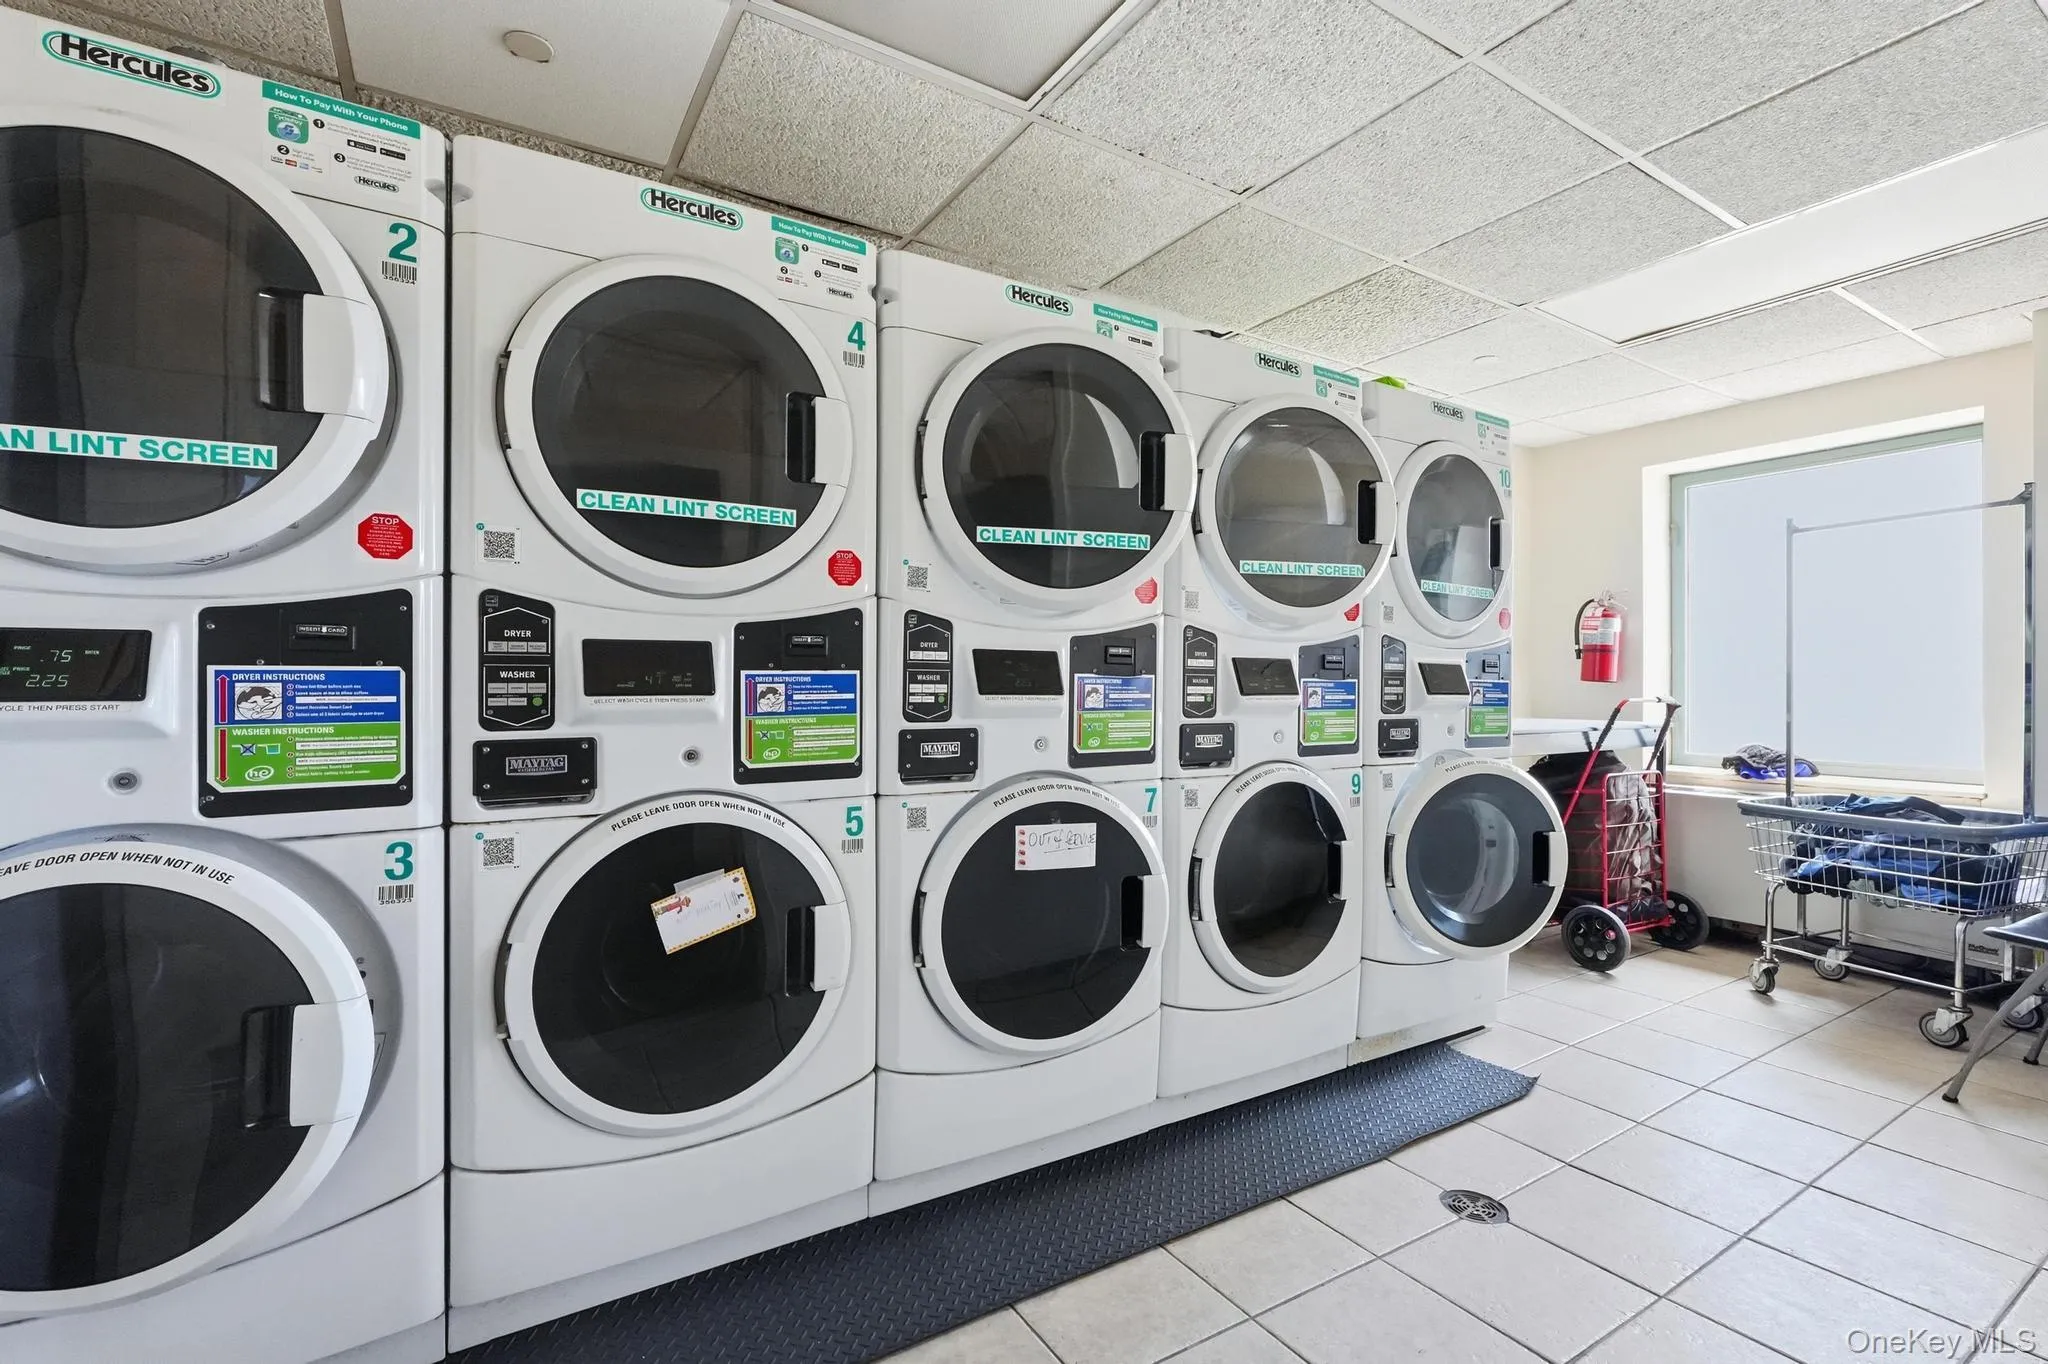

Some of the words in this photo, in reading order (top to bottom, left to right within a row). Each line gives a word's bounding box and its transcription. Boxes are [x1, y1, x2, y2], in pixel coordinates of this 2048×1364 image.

[61, 33, 209, 92] Hercules
[274, 88, 298, 100] How
[300, 96, 312, 105] To
[313, 98, 331, 111] Pay
[332, 104, 356, 117] With
[356, 111, 378, 123] Your
[380, 118, 409, 131] Phone
[357, 176, 396, 192] Hercules
[650, 188, 738, 226] Hercules
[389, 222, 417, 263] 2
[778, 222, 792, 230] How
[801, 228, 812, 237] Pay
[812, 232, 826, 240] With
[828, 236, 840, 244] Your
[842, 240, 860, 249] Phone
[1012, 286, 1068, 312] Hercules
[848, 321, 866, 351] 4
[1258, 353, 1299, 374] Hercules
[1432, 402, 1463, 419] Hercules
[48, 432, 127, 456] LINT
[139, 438, 273, 468] SCREEN
[1500, 469, 1510, 488] 10
[372, 516, 399, 524] STOP
[581, 492, 654, 512] CLEAN
[662, 499, 709, 516] LINT
[715, 504, 794, 526] SCREEN
[980, 528, 1036, 543] CLEAN
[1042, 532, 1078, 544] LINT
[1083, 534, 1148, 548] SCREEN
[1242, 562, 1282, 573] CLEAN
[1288, 564, 1313, 574] LINT
[1317, 566, 1363, 576] SCREEN
[1422, 582, 1446, 592] CLEAN
[1448, 584, 1464, 594] LINT
[1466, 586, 1492, 597] SCREEN
[504, 630, 532, 638] DRYER
[25, 675, 70, 688] 2.25
[232, 728, 270, 736] WASHER
[273, 726, 334, 735] INSTRUCTIONS
[924, 744, 958, 752] MAYTAG
[510, 758, 564, 769] MAYTAG
[994, 793, 1019, 807] PLEASE
[1016, 786, 1036, 796] LEAVE
[1038, 784, 1055, 792] DOOR
[1352, 774, 1360, 794] 9
[1145, 788, 1157, 812] 7
[611, 813, 644, 832] PLEASE
[644, 805, 671, 817] LEAVE
[673, 801, 696, 809] DOOR
[699, 800, 720, 808] OPEN
[722, 802, 746, 812] WHEN
[747, 808, 762, 816] NOT
[763, 812, 771, 820] IN
[772, 816, 785, 828] USE
[846, 806, 863, 836] 5
[34, 854, 76, 868] DOOR
[80, 851, 118, 862] OPEN
[121, 852, 161, 864] WHEN
[163, 858, 193, 870] NOT
[192, 864, 208, 875] IN
[208, 870, 236, 885] USE
[384, 842, 414, 880] 3
